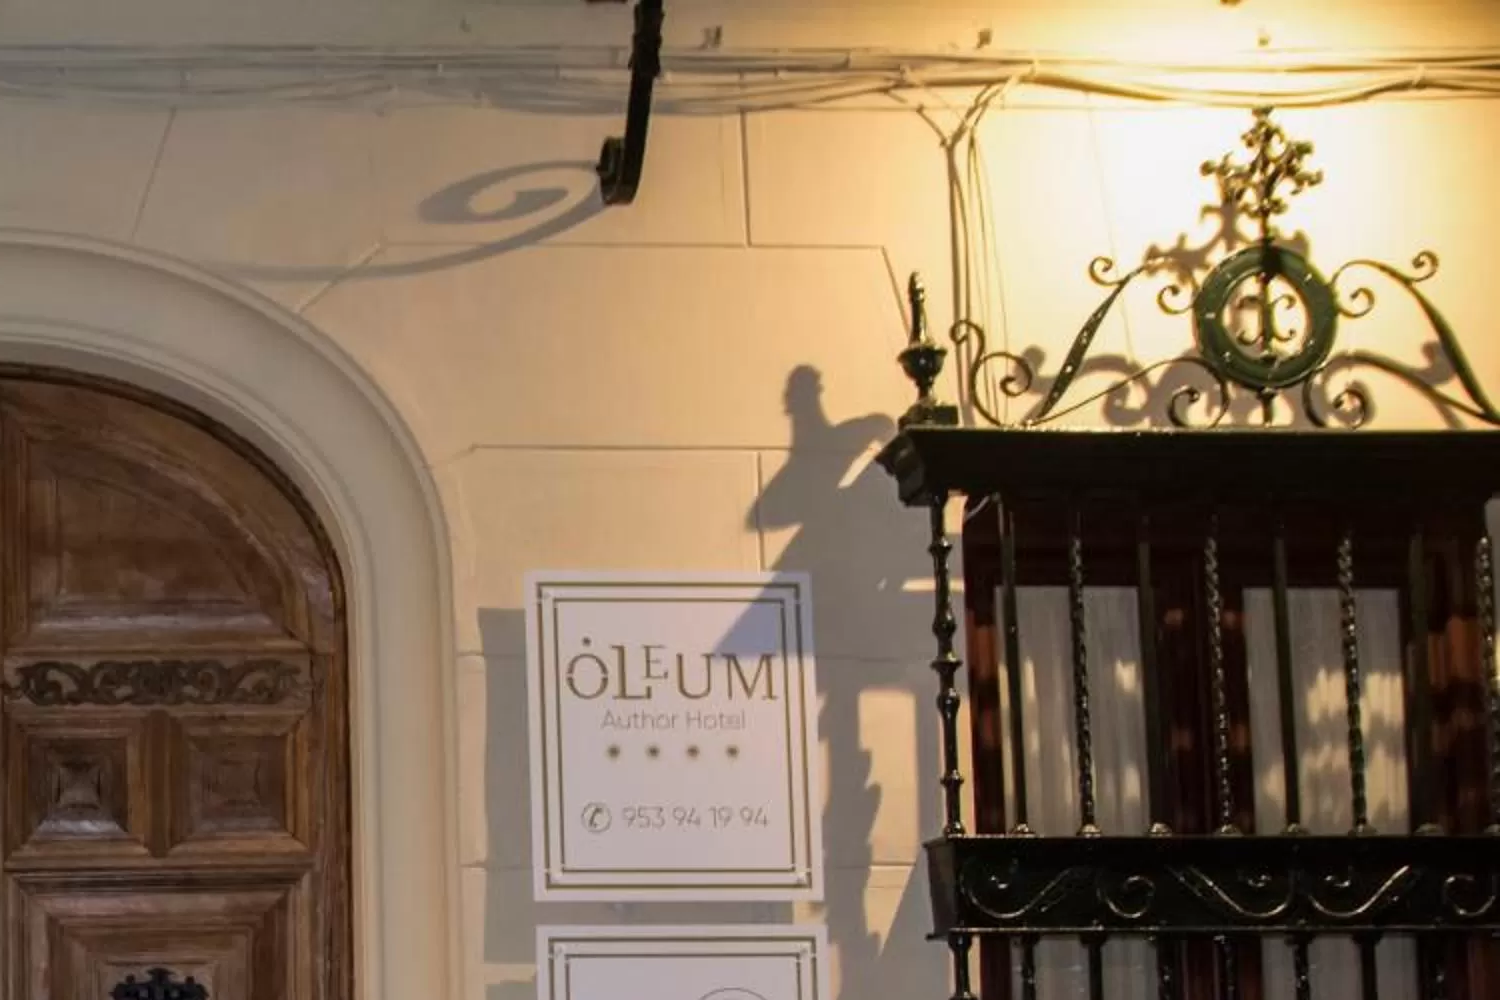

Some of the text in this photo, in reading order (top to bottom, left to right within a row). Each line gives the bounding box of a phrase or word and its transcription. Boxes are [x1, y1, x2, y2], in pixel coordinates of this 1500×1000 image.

[601, 709, 746, 731] Author Hotel
[621, 806, 770, 829] 953 94 19 94
